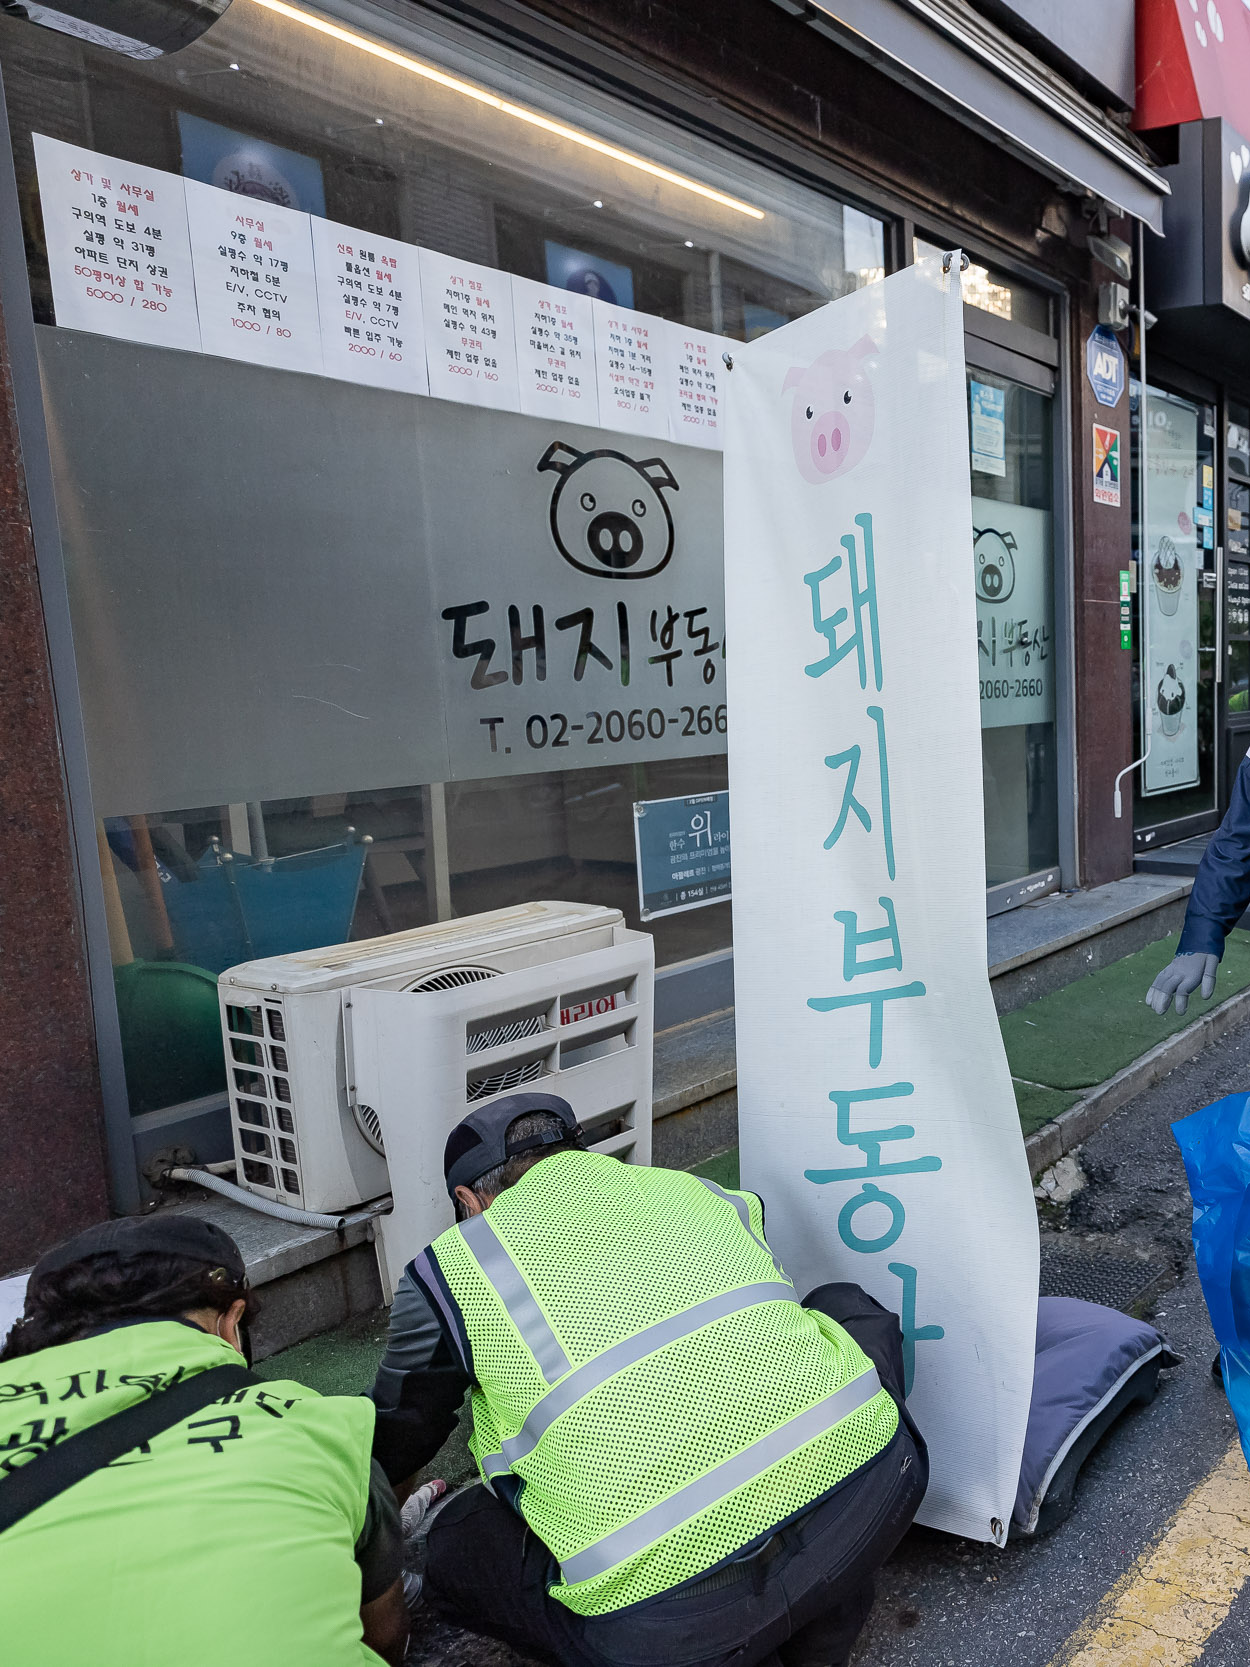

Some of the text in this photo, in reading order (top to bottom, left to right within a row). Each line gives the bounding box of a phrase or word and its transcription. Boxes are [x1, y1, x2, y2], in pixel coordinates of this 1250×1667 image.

[71, 169, 154, 202] 상가 및 사무실
[91, 193, 139, 216] 1층 월세
[72, 207, 162, 240] 구의역 도보 4분
[236, 216, 264, 232] 사무실
[83, 230, 155, 258] 실평 약 31평
[231, 231, 272, 251] 9층 월세
[74, 246, 168, 278] 아파트 단지 상권
[218, 245, 288, 272] 실평수 약 17평
[74, 265, 172, 298] 50평이상 합 가능
[230, 265, 281, 287] 지하철 5분
[86, 287, 167, 312] 5000 280
[255, 289, 287, 303] CCTV
[237, 302, 281, 321] 주차 협의
[231, 318, 291, 338] 1000 80
[448, 364, 472, 376] 2000
[1093, 351, 1118, 383] ADT
[441, 600, 726, 690] 돼지부동
[480, 716, 511, 754] T.
[688, 810, 712, 847] 위
